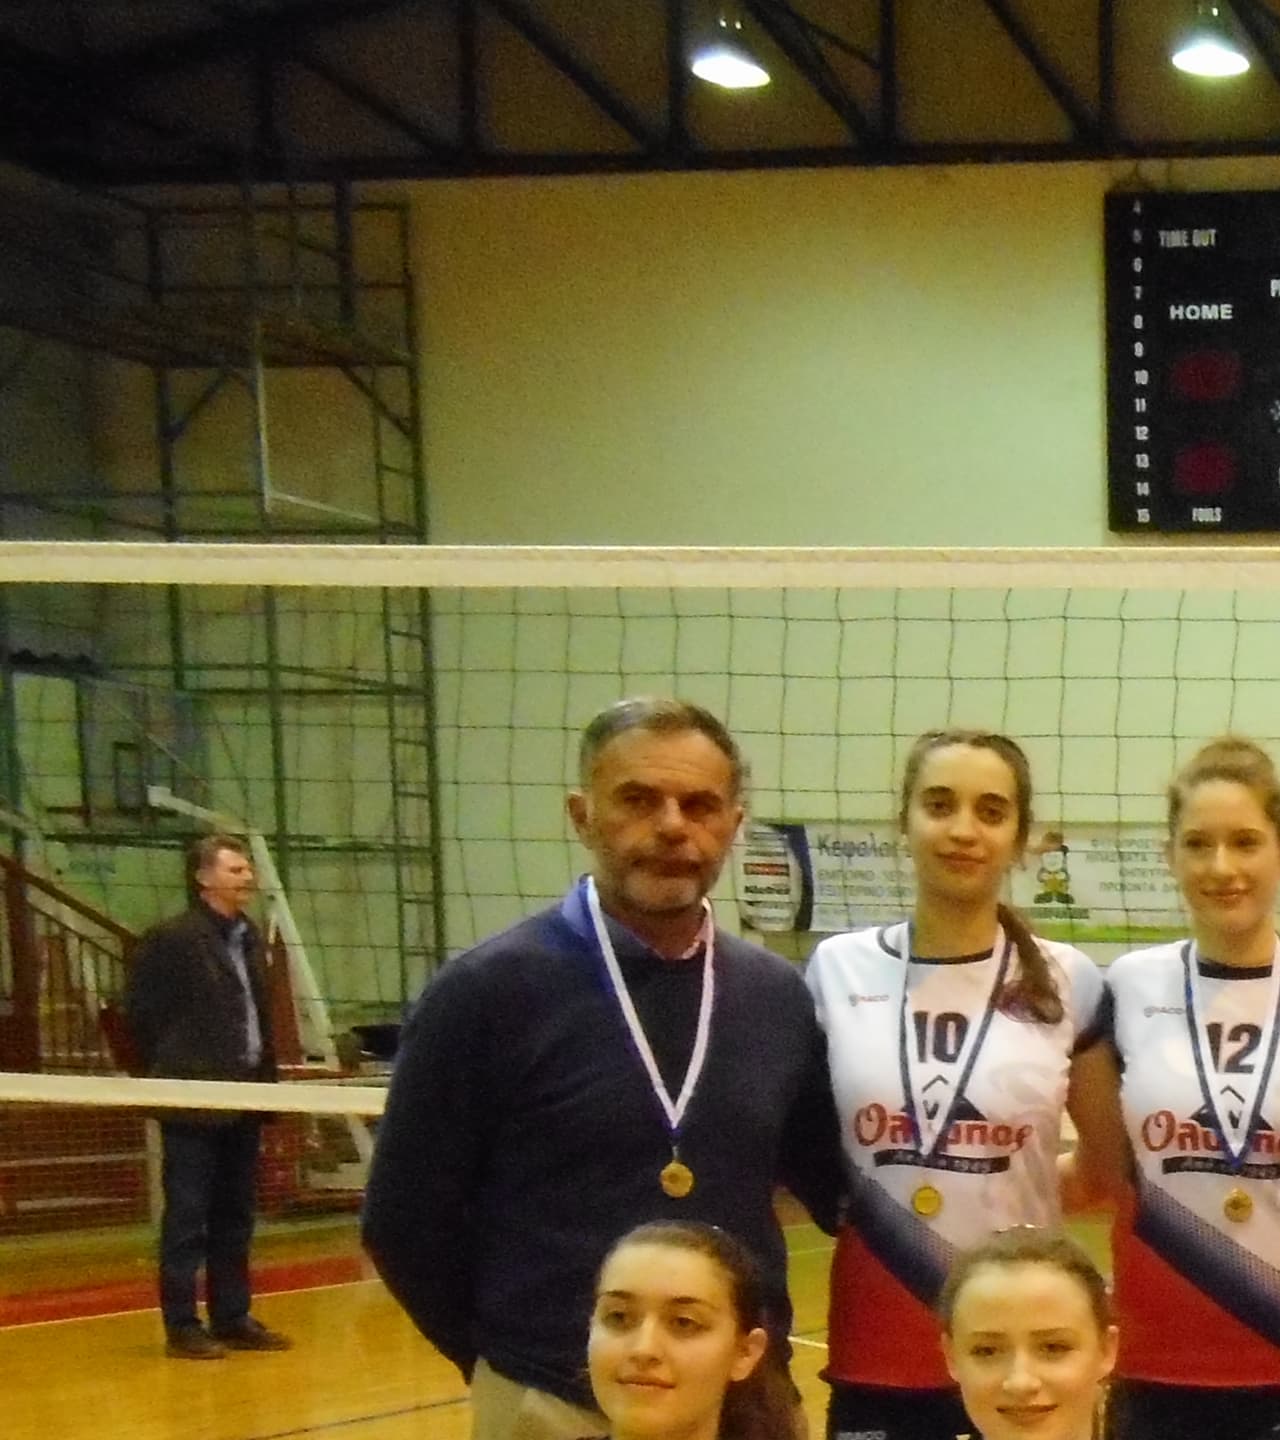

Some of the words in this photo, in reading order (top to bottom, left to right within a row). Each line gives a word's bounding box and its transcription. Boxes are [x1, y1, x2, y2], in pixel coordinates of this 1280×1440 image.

[1159, 229, 1189, 248] TIME
[1192, 228, 1217, 248] OUT
[1169, 304, 1233, 320] HOME
[1135, 398, 1146, 413] 11
[1135, 425, 1149, 440] 12
[913, 1011, 971, 1064] 10
[1206, 1022, 1263, 1074] 12
